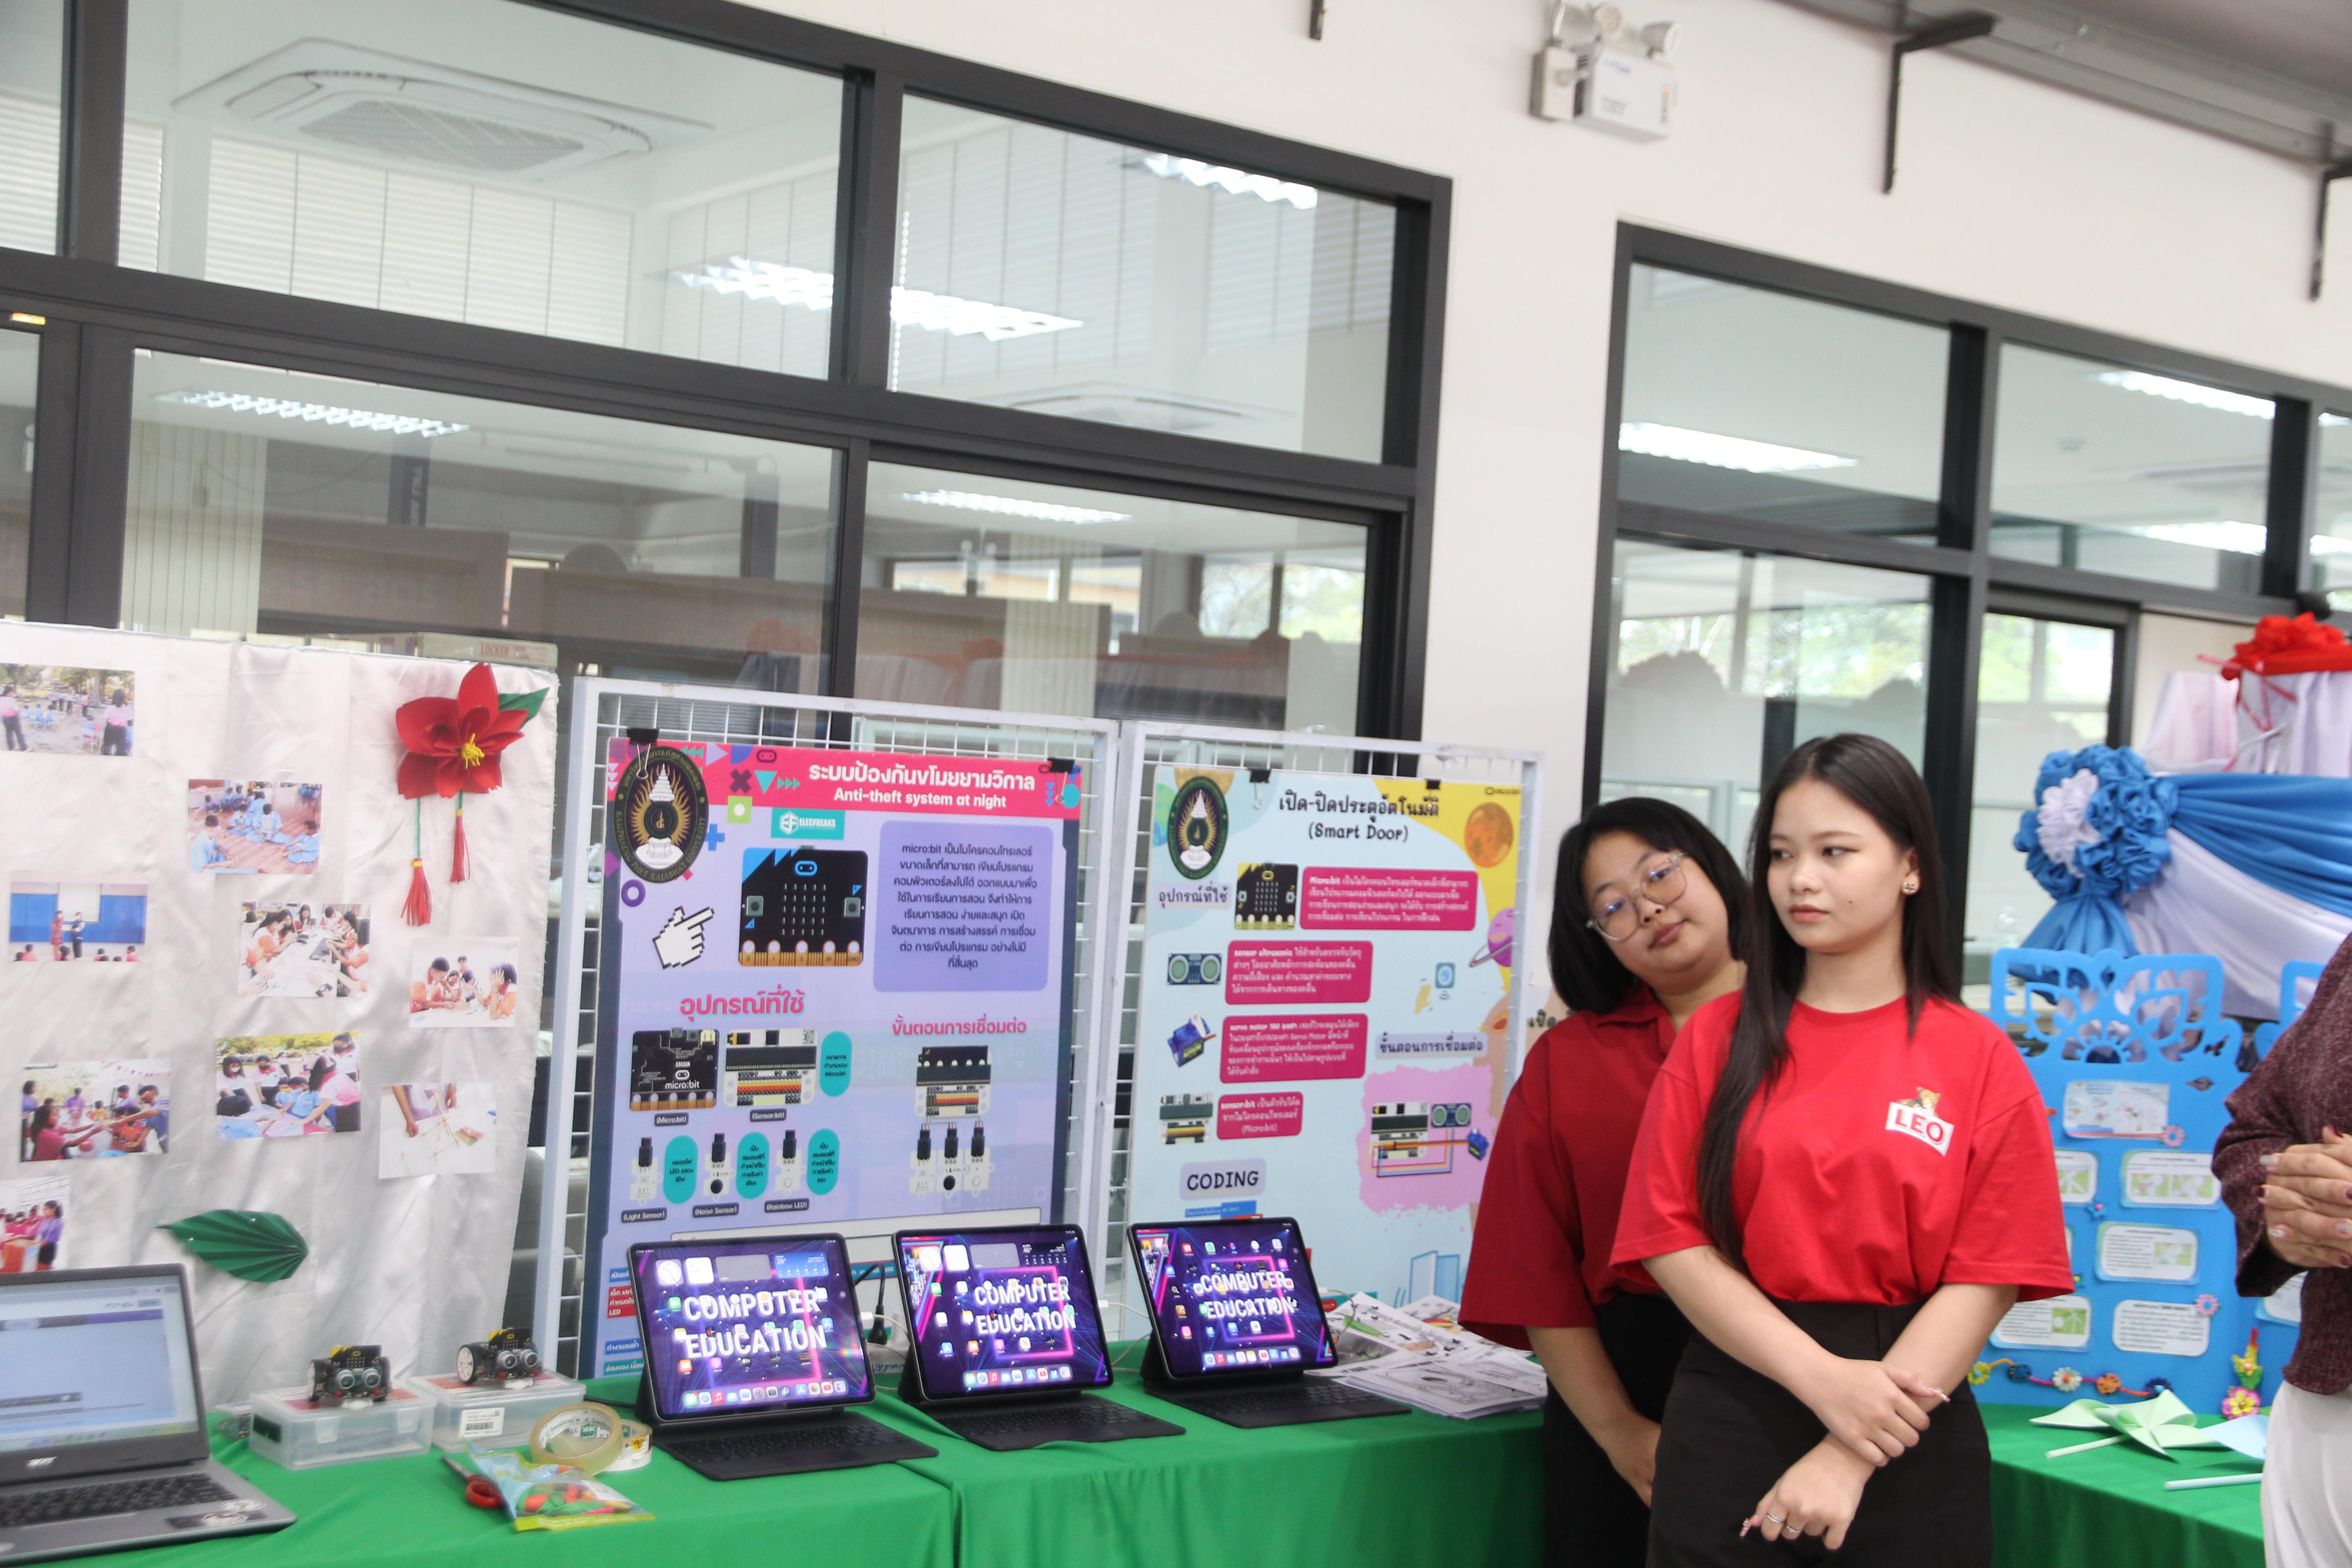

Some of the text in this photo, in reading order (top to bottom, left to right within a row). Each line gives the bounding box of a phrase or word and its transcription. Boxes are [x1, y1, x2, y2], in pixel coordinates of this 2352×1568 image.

[809, 760, 1035, 790] ระบบป้องกันขโมยยามวิกาล
[834, 787, 1006, 810] Anti-theft system at night
[1279, 789, 1439, 823] เปิด-ปิดประตูอัตโนมัติ
[1309, 822, 1408, 842] (Smart Door)
[902, 844, 941, 853] micro:bit
[900, 858, 1033, 872] ขนาดเล็กที่สามารถ เขียนโปรแกรม
[894, 875, 1037, 888] คอมพิวเตอร์ลงไปได้ ออกแบบมาเพื่อ
[897, 891, 1032, 904] ใช้ในการเรียนการสอน จึงทำให้การ
[1159, 880, 1228, 908] อุปกรณ์ที่ใช้
[904, 908, 1025, 921] เรียนการสอน ง่ายและสนุก เปิด
[939, 925, 997, 936] การสร้างสรรค์
[1000, 923, 1036, 936] การเชื่อม
[900, 941, 912, 951] ต่อ
[916, 941, 988, 952] การเขียนโปรแกรม
[948, 955, 978, 970] ที่สิ้นสุด
[681, 984, 805, 1022] อุปกรณ์ที่ใช้
[892, 1013, 1026, 1035] ขั้นตอนการเชื่อมต่อ
[1380, 1030, 1483, 1053] ขั้นตอนการเชื่อมต่อ
[665, 1080, 700, 1089] micro:bit
[1895, 1108, 1944, 1142] LEO
[1187, 1171, 1259, 1191] CODING
[642, 1210, 665, 1220] Sensor)
[714, 1206, 737, 1215] Sensor)
[975, 1282, 1071, 1306] COMPUTER
[684, 1289, 822, 1320] COMPUTER
[976, 1310, 1077, 1335] EDUCATION
[685, 1324, 827, 1358] EDUCATION
